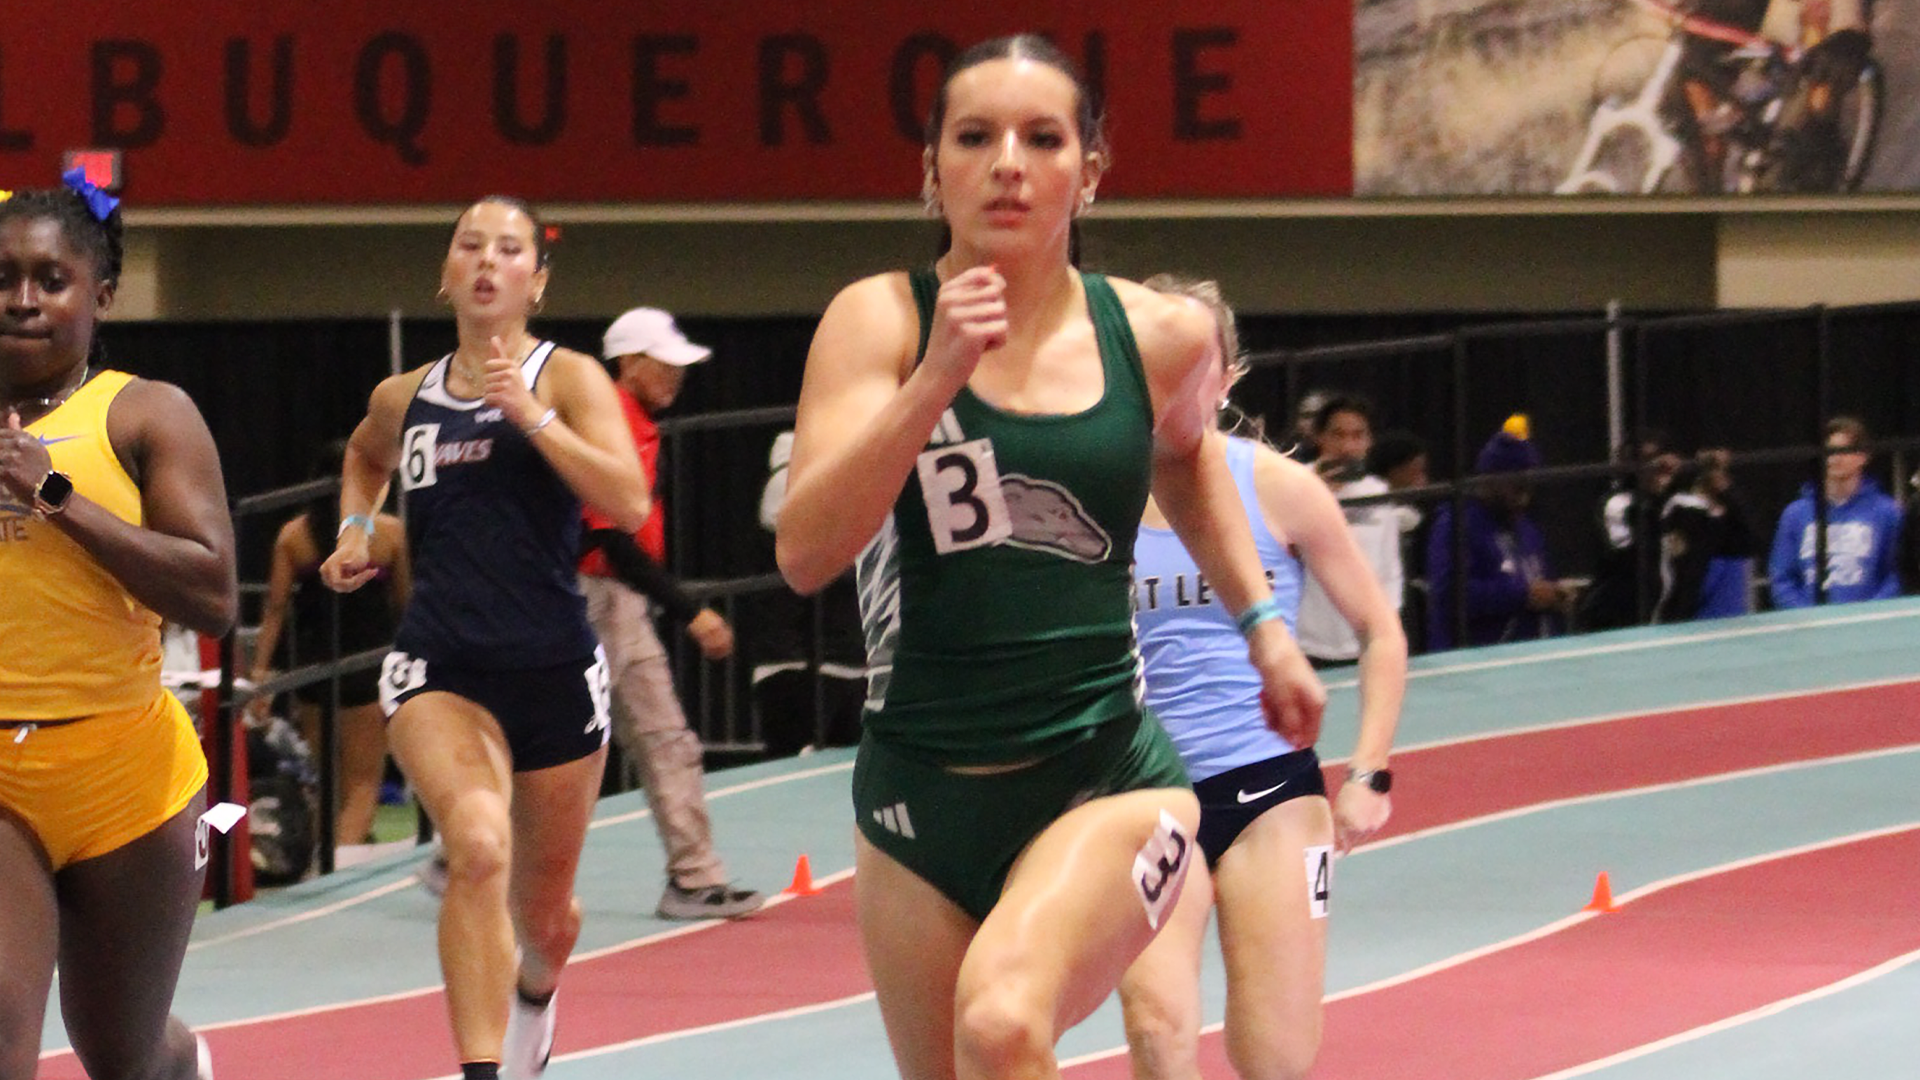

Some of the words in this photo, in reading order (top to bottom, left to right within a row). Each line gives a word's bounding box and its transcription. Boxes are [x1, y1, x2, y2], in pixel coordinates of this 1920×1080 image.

[408, 429, 426, 484] 6
[935, 452, 990, 544] 3
[1141, 828, 1187, 904] 3
[1315, 851, 1330, 915] 4
